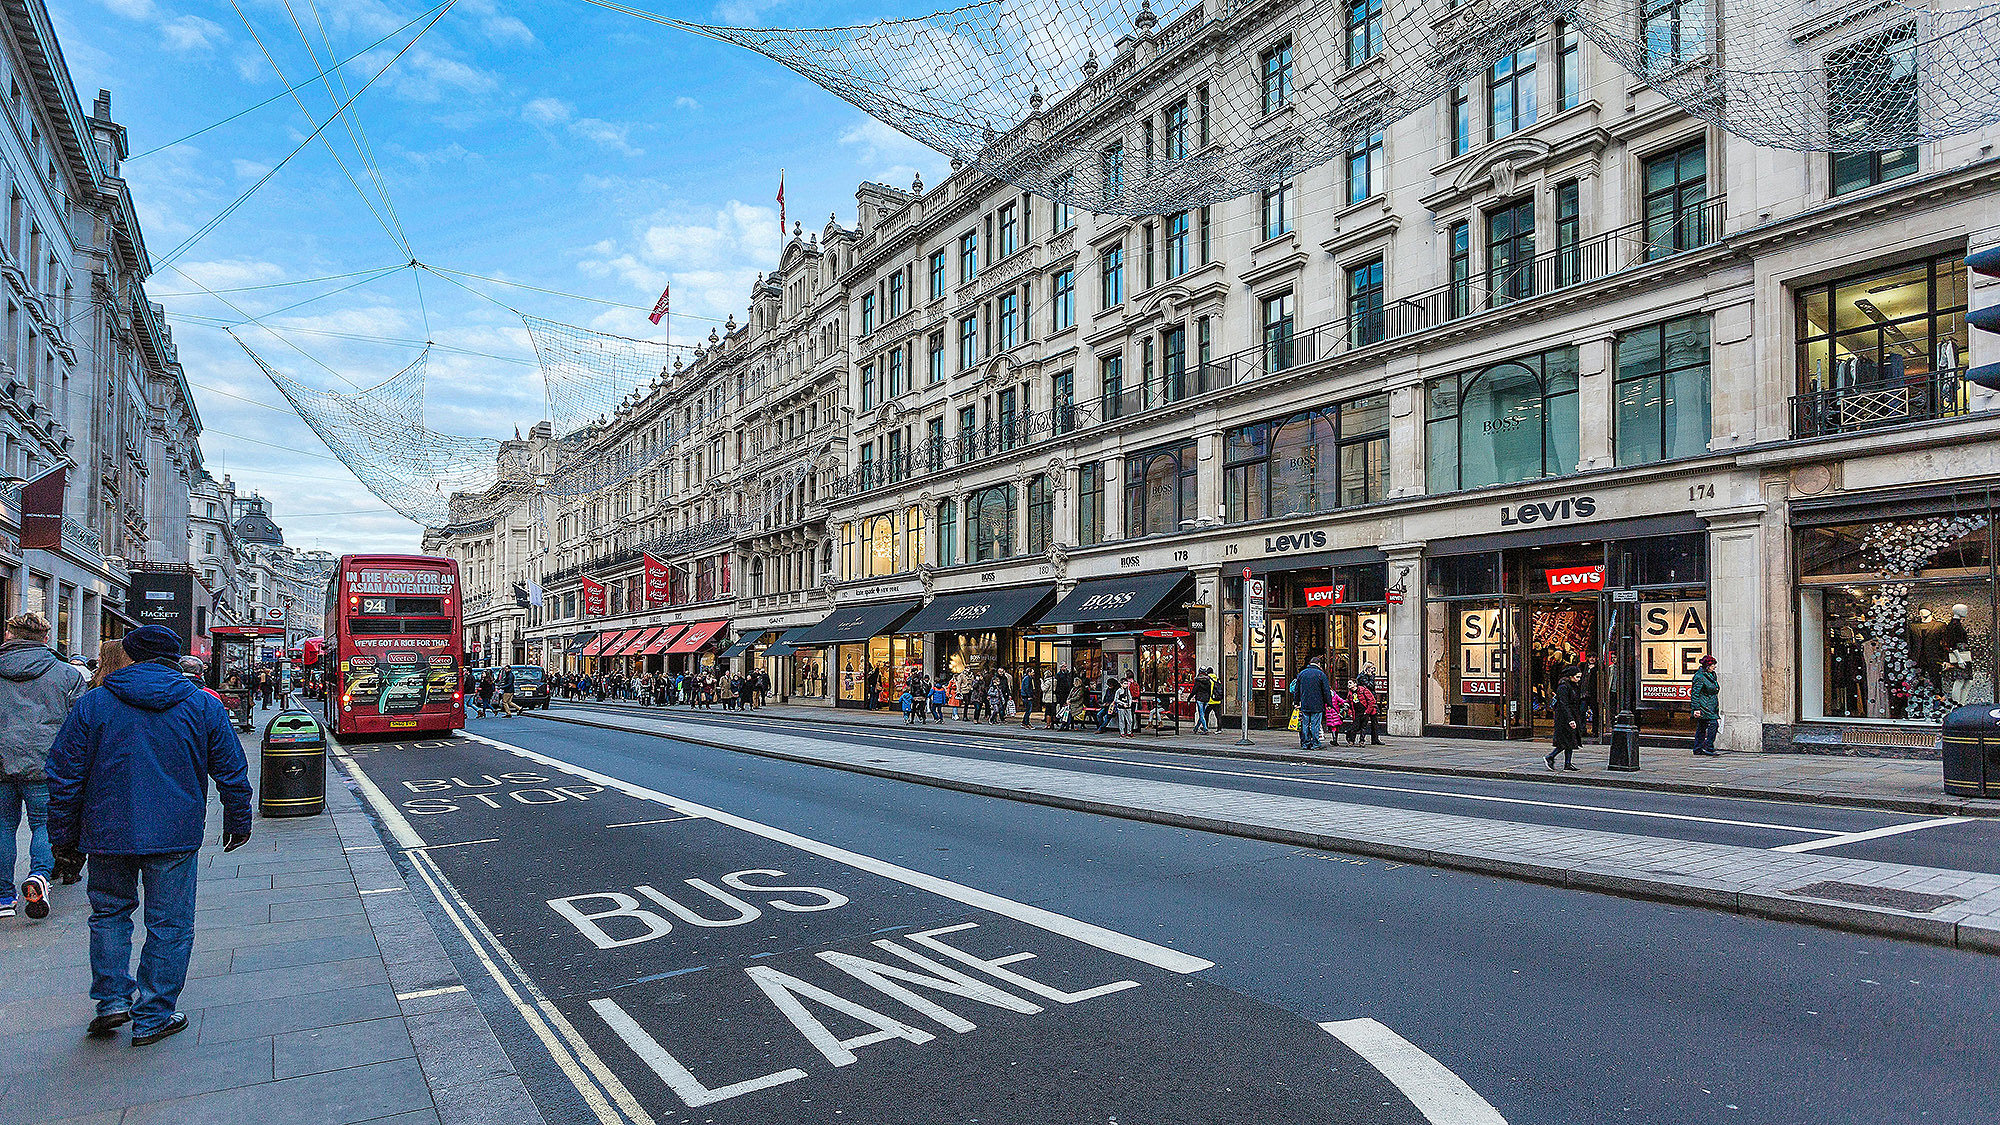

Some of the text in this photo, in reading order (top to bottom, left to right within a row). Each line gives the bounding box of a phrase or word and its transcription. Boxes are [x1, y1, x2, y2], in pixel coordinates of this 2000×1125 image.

[1483, 415, 1520, 431] BOSS
[1290, 455, 1316, 468] BOSS
[1152, 484, 1172, 495] BOSS
[1688, 484, 1715, 501] 174
[1501, 496, 1596, 526] LEVI'S
[1265, 531, 1327, 553] LEVI'S
[1173, 551, 1189, 561] 178
[1225, 544, 1238, 556] 176
[1121, 556, 1140, 565] BOSS
[346, 572, 455, 584] IN THE MOOD FOR AN
[1551, 572, 1601, 586] LEVI'S
[349, 583, 453, 594] ASIAN ADVENTURE?
[364, 599, 385, 613] 94
[1081, 591, 1136, 607] BOSS
[140, 610, 180, 618] HACKETT
[950, 604, 991, 617] BOSS
[1647, 607, 1705, 635] SA
[1652, 647, 1702, 674] LE
[1257, 679, 1280, 688] SAE
[1470, 682, 1501, 693] SALE
[402, 772, 549, 793] BUS
[402, 785, 605, 815] STOP
[545, 869, 850, 950] BUS
[588, 922, 1142, 1109] LANE
